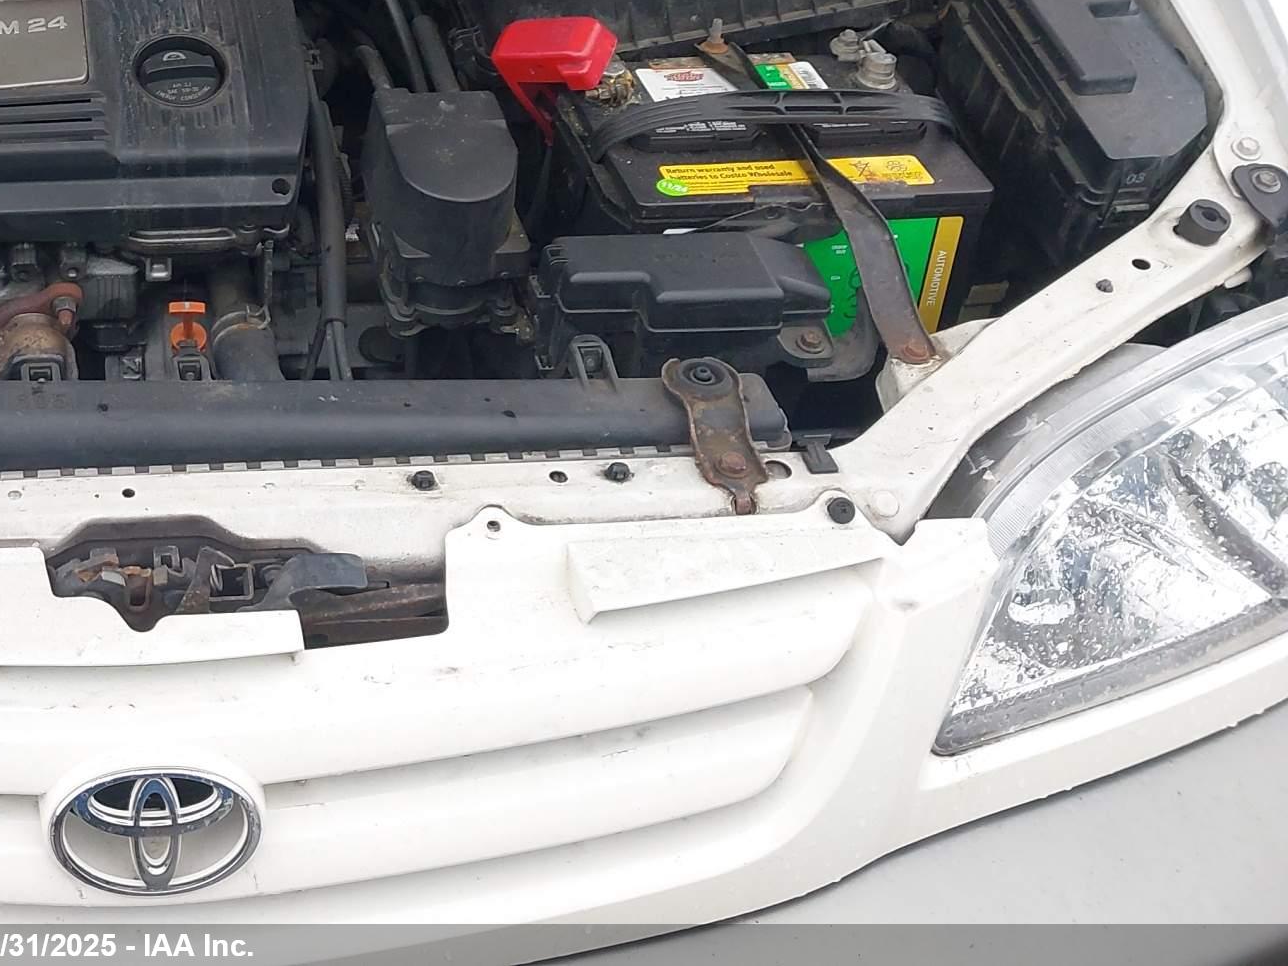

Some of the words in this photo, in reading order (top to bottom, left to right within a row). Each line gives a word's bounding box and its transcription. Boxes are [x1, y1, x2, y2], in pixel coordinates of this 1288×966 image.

[27, 15, 69, 33] 24
[748, 170, 793, 178] Wholesale
[926, 250, 948, 307] AUTOMOTIVE
